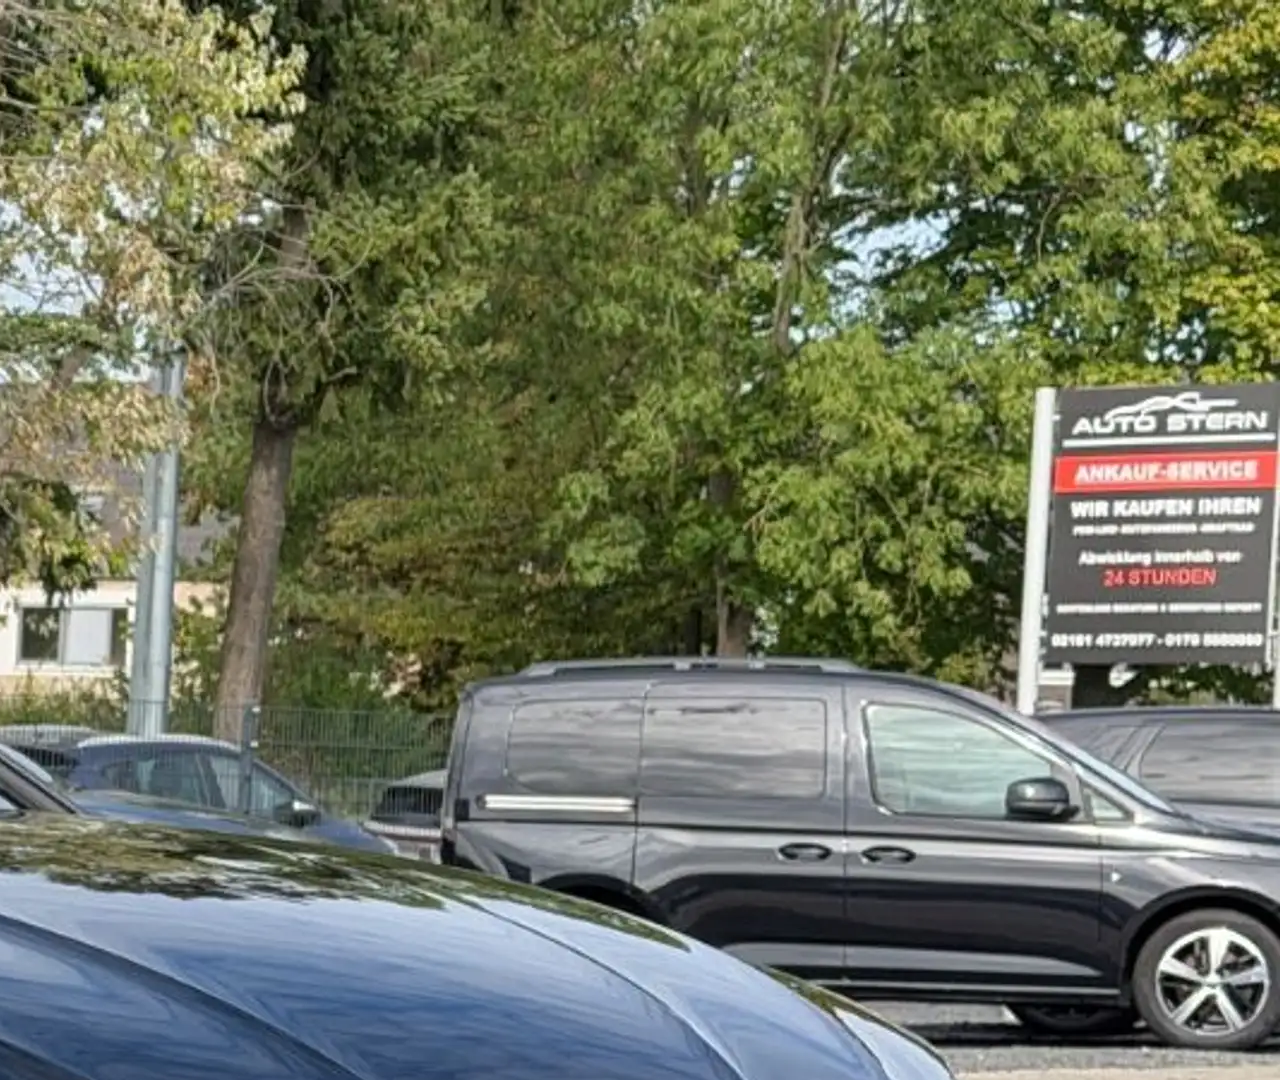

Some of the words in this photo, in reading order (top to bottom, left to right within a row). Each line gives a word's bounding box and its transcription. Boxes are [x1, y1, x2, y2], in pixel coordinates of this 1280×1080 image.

[1071, 413, 1157, 435] AUTO
[1166, 411, 1268, 432] STERN
[1074, 460, 1259, 485] ANKAUF-SERVICE
[1070, 501, 1110, 519] WIR
[1113, 499, 1193, 517] KAUFEN
[1198, 497, 1263, 515] IHREN
[1103, 570, 1125, 587] 24
[1127, 568, 1217, 586] STUNDEN
